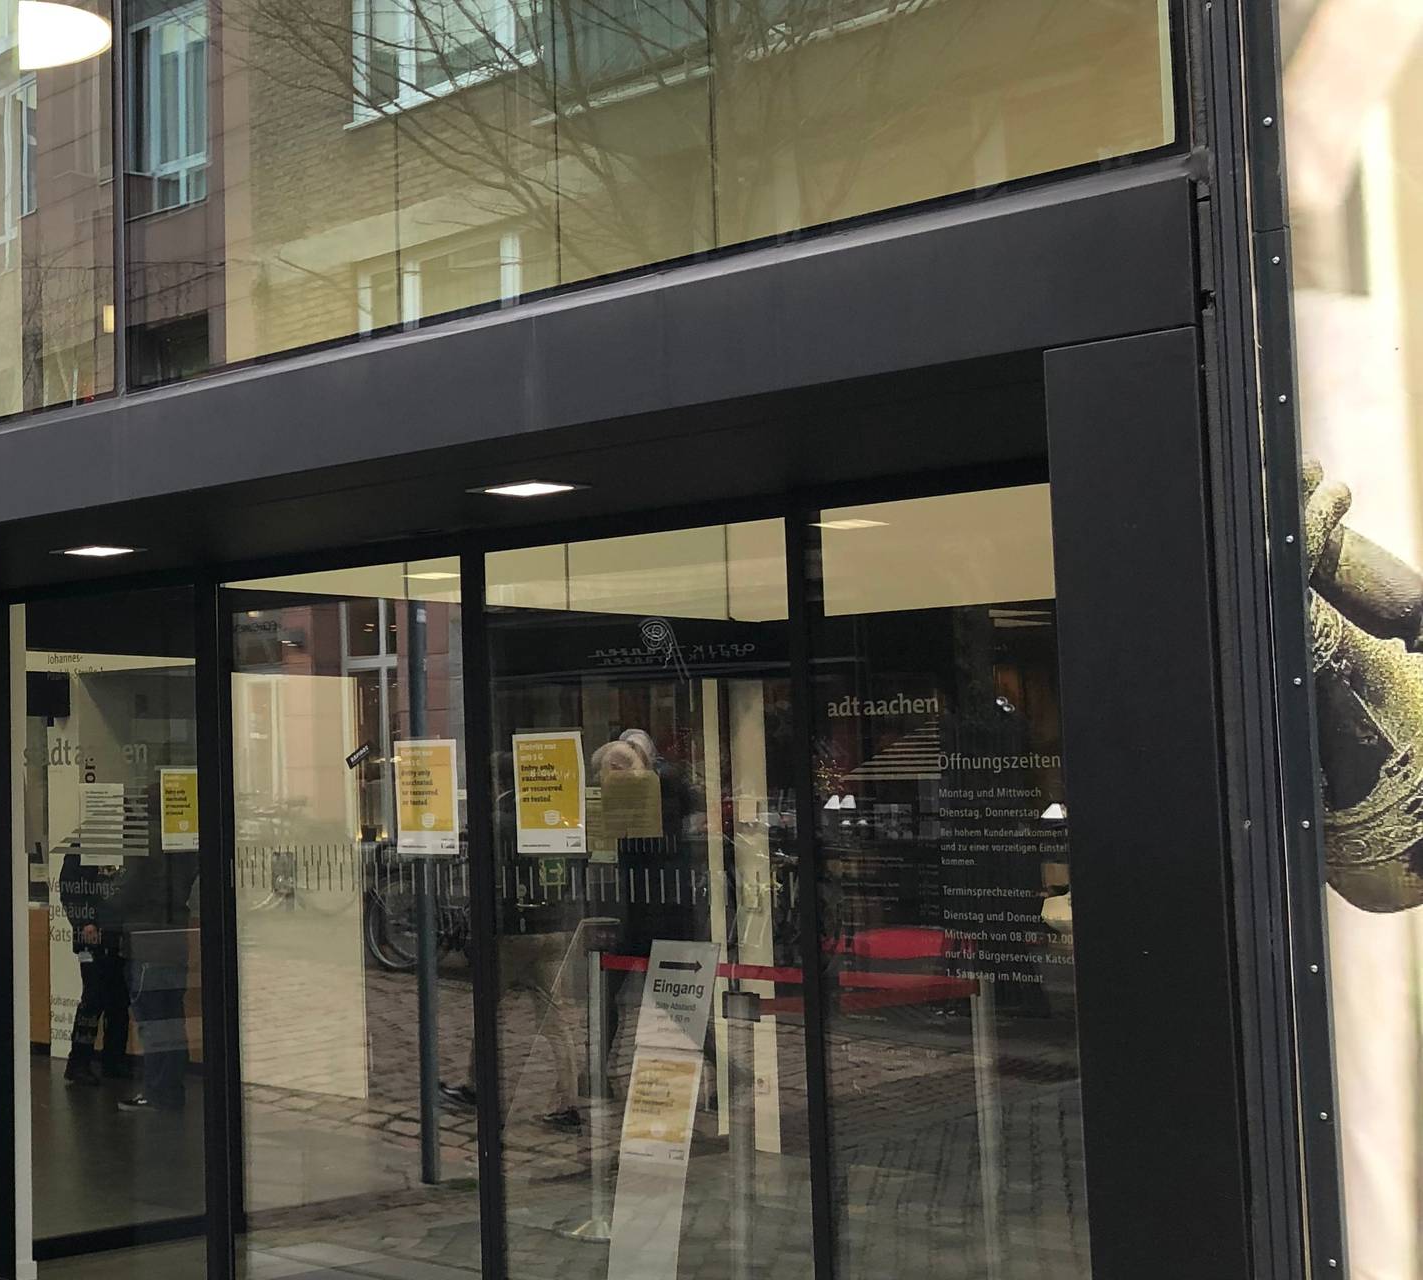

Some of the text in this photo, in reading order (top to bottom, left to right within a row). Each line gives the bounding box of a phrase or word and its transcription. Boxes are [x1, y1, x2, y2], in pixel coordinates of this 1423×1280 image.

[864, 692, 939, 715] aachen
[938, 751, 1061, 773] Öffnungszeiten
[938, 786, 1042, 800] Montag und Mittwoch
[985, 807, 1040, 819] Donnerstag
[955, 828, 981, 837] hohem
[940, 842, 956, 852] und
[958, 844, 968, 852] zu
[969, 843, 990, 852] einer
[48, 876, 121, 900] Verwaltungs-
[49, 901, 95, 921] gebäude
[943, 909, 984, 923] Dienstag
[986, 911, 1004, 921] und
[944, 929, 988, 940] Mittwoch
[990, 932, 1007, 941] von
[945, 950, 961, 959] nur
[963, 949, 976, 960] für
[978, 950, 1043, 964] Bürgerservice
[956, 968, 996, 984] Samstag
[998, 972, 1010, 981] im
[1012, 972, 1043, 984] Monat
[652, 978, 705, 999] Eingang
